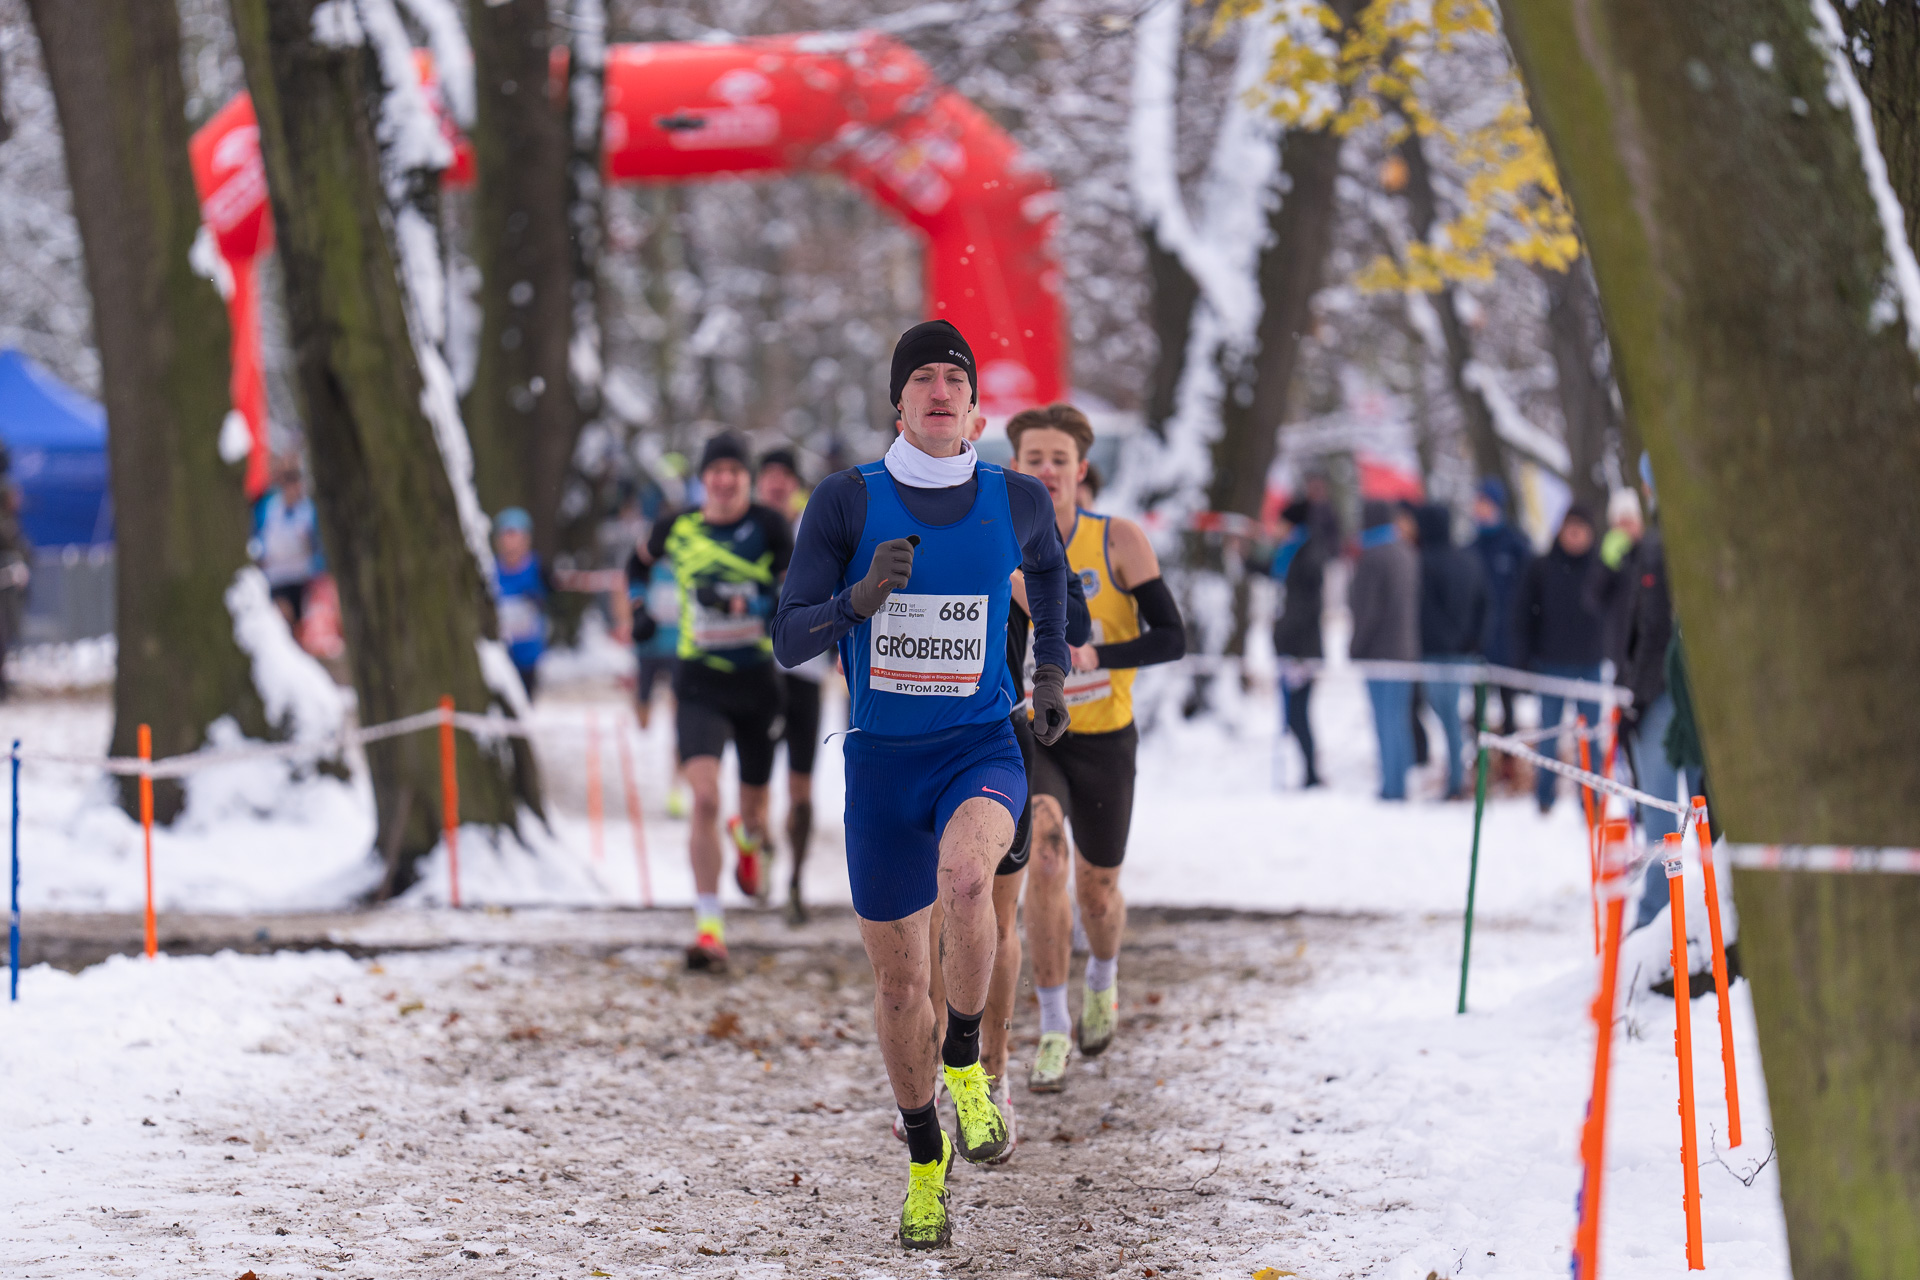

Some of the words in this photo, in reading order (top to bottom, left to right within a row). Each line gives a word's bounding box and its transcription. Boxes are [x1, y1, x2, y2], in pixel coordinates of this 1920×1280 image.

[888, 602, 907, 612] 770
[939, 602, 979, 621] 686
[896, 683, 931, 693] BYTOM
[934, 685, 960, 693] 2024
